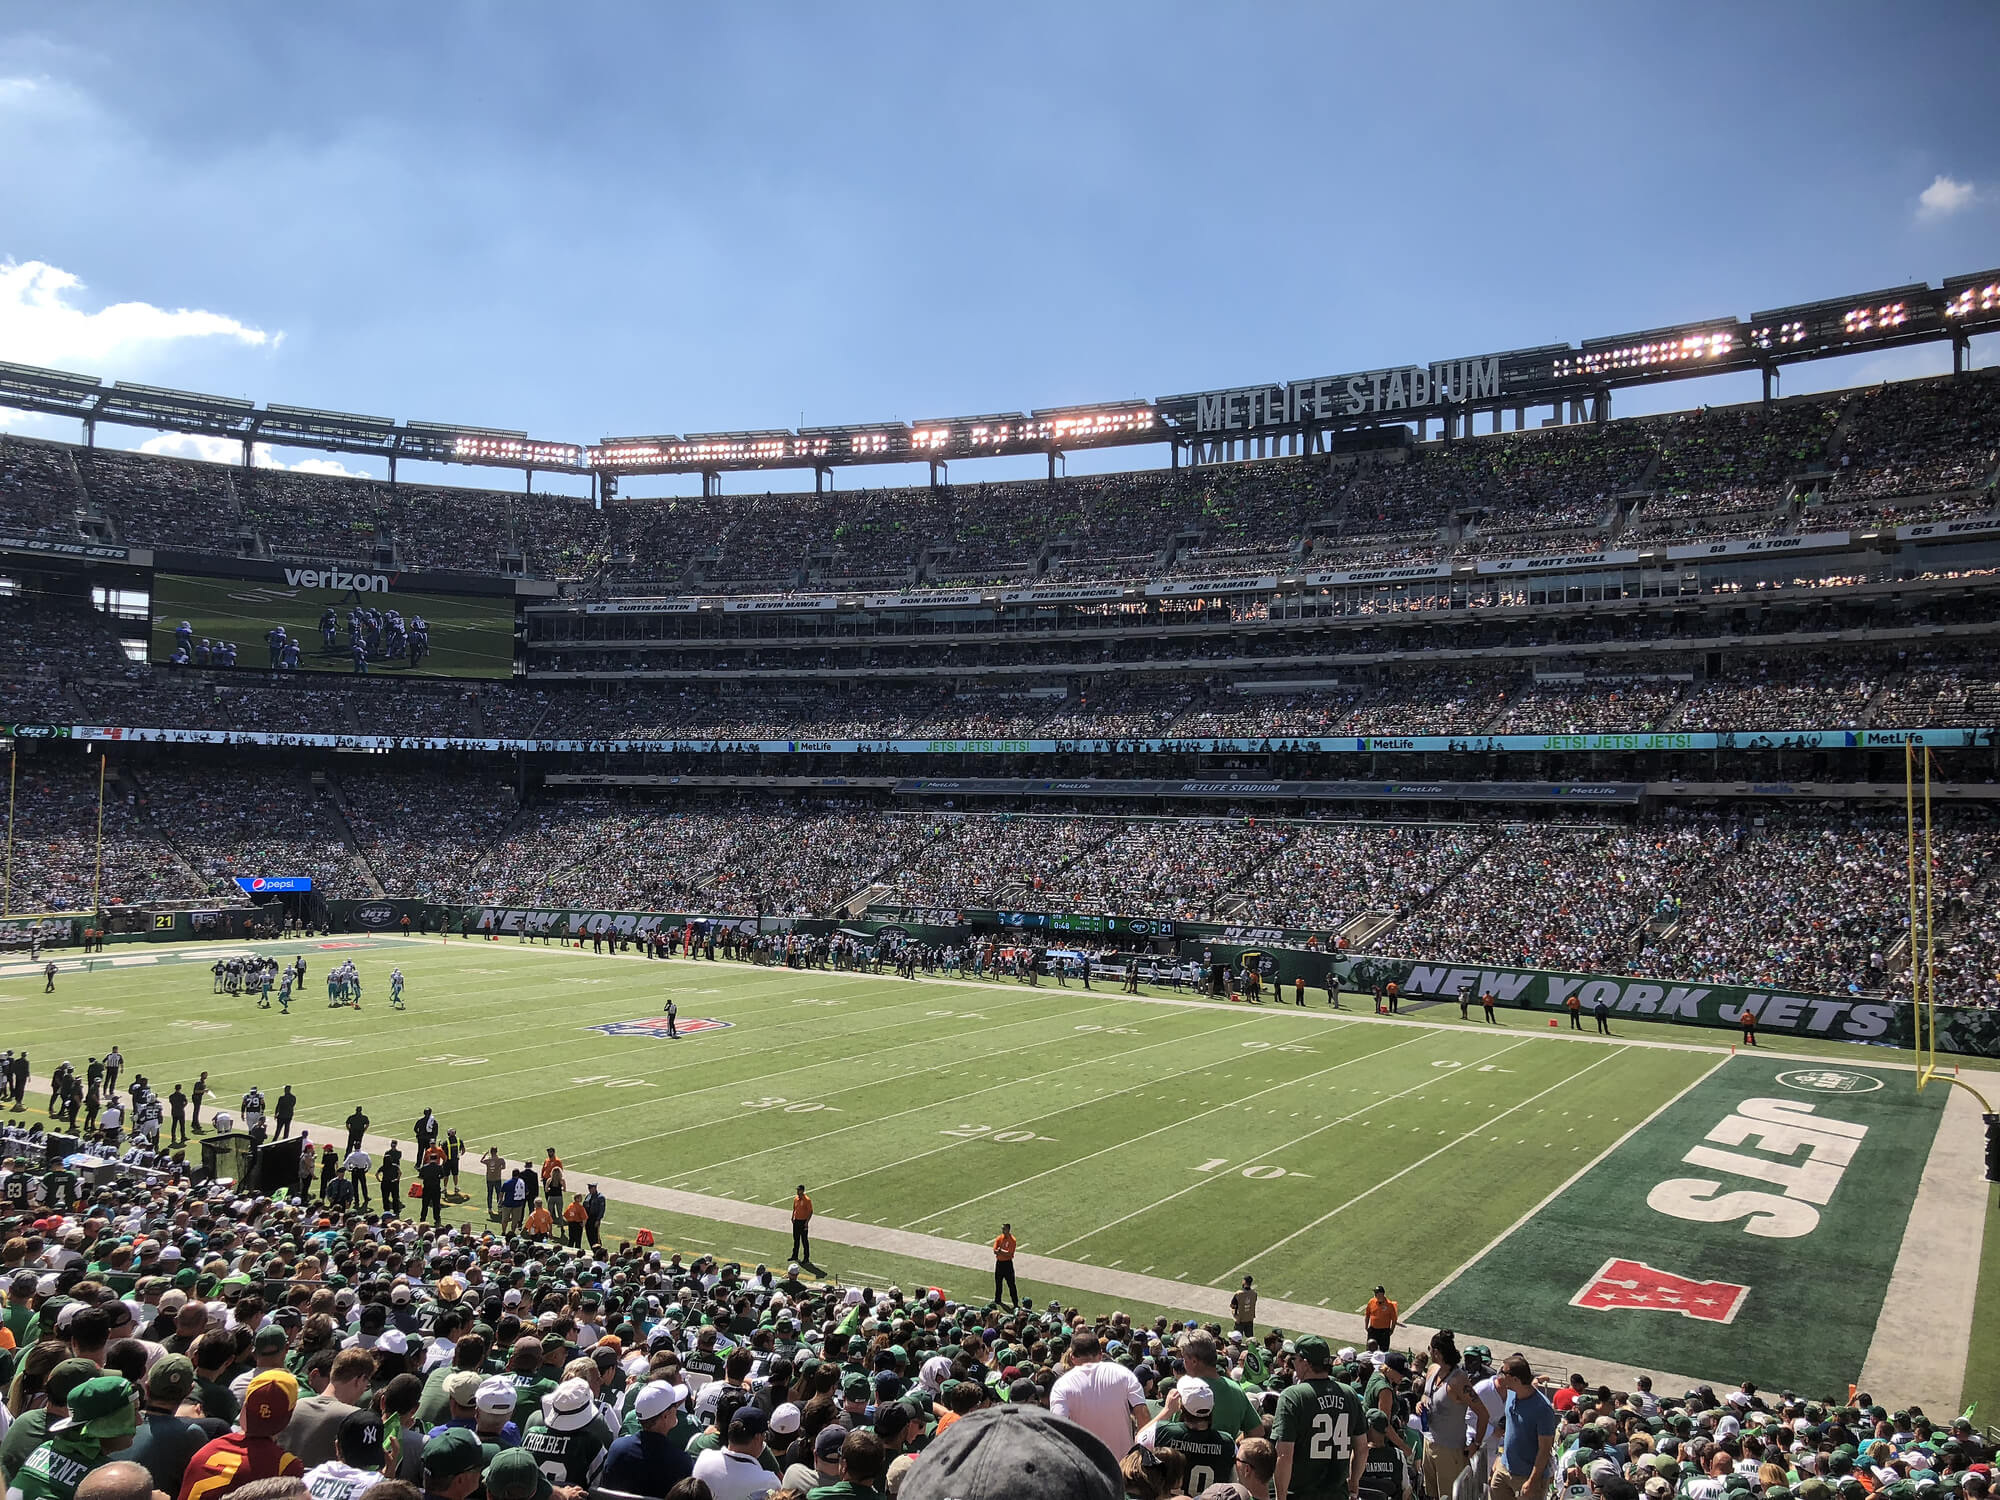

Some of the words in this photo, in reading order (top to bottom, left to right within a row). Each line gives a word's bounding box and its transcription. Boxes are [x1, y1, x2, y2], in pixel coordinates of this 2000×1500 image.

[1197, 381, 1333, 433] METLIFE
[1345, 357, 1499, 415] STADIUM
[1911, 526, 1934, 536] 85
[0, 537, 27, 547] ME
[29, 541, 52, 549] OF
[53, 543, 85, 554] THE
[86, 547, 126, 558] JETS
[1746, 541, 1762, 550] AL
[1766, 539, 1801, 548] TOON
[1496, 562, 1512, 570] 41
[1527, 558, 1564, 568] MATT
[1565, 554, 1606, 565] SNELL
[284, 566, 389, 593] verizon
[1348, 571, 1388, 581] GERRY
[1388, 567, 1438, 578] PHILBIN
[1162, 585, 1175, 593] 12
[1188, 583, 1210, 591] JOE
[1211, 580, 1259, 590] NAMATH
[922, 596, 969, 604] MAYNARD
[1031, 591, 1081, 600] FREEMAN
[617, 604, 651, 612] CURTIS
[754, 601, 783, 609] KEVIN
[1373, 739, 1414, 749] MetLife
[1543, 736, 1587, 750] JETS!
[1593, 736, 1638, 750] JETS!
[1645, 735, 1691, 749] JETS!
[1868, 733, 1923, 744] MetLife
[801, 742, 832, 751] MetLife
[926, 741, 958, 752] JETS!
[961, 741, 993, 752] JETS!
[997, 741, 1031, 752] JETS!
[927, 781, 960, 789] MetLife
[1055, 782, 1091, 790] MetLife
[1181, 784, 1228, 792] METLIFE
[1229, 784, 1280, 792] STADIUM
[1570, 787, 1616, 795] MetLife
[267, 880, 294, 889] pepsi
[360, 909, 391, 919] JETS
[1038, 915, 1045, 925] 7
[156, 915, 172, 927] 21
[477, 910, 561, 933] NEW
[569, 912, 671, 936] YORK
[1053, 921, 1070, 929] 0:48
[1108, 919, 1115, 929] 0
[1161, 923, 1171, 933] 21
[1224, 927, 1246, 938] NY
[1246, 929, 1283, 939] JETS
[1403, 964, 1535, 1001] NEW
[1543, 978, 1713, 1019] YORK
[1718, 993, 1898, 1038] JETS
[246, 1098, 260, 1107] 79
[740, 1097, 826, 1114] 30
[939, 1123, 1037, 1143] 20
[1188, 1158, 1288, 1180] 10
[1646, 1097, 1870, 1239] JETS
[7, 1182, 22, 1198] 83
[55, 1184, 66, 1202] 4
[420, 1313, 437, 1331] 7
[1317, 1394, 1345, 1410] REVIS
[363, 1425, 377, 1444] NY
[1310, 1413, 1351, 1459] 24
[521, 1432, 571, 1455] CHREBET
[1170, 1440, 1222, 1455] PENNINGTON
[24, 1447, 88, 1487] GREENE
[1366, 1462, 1394, 1473] DARNOLD
[310, 1477, 356, 1500] REVIS
